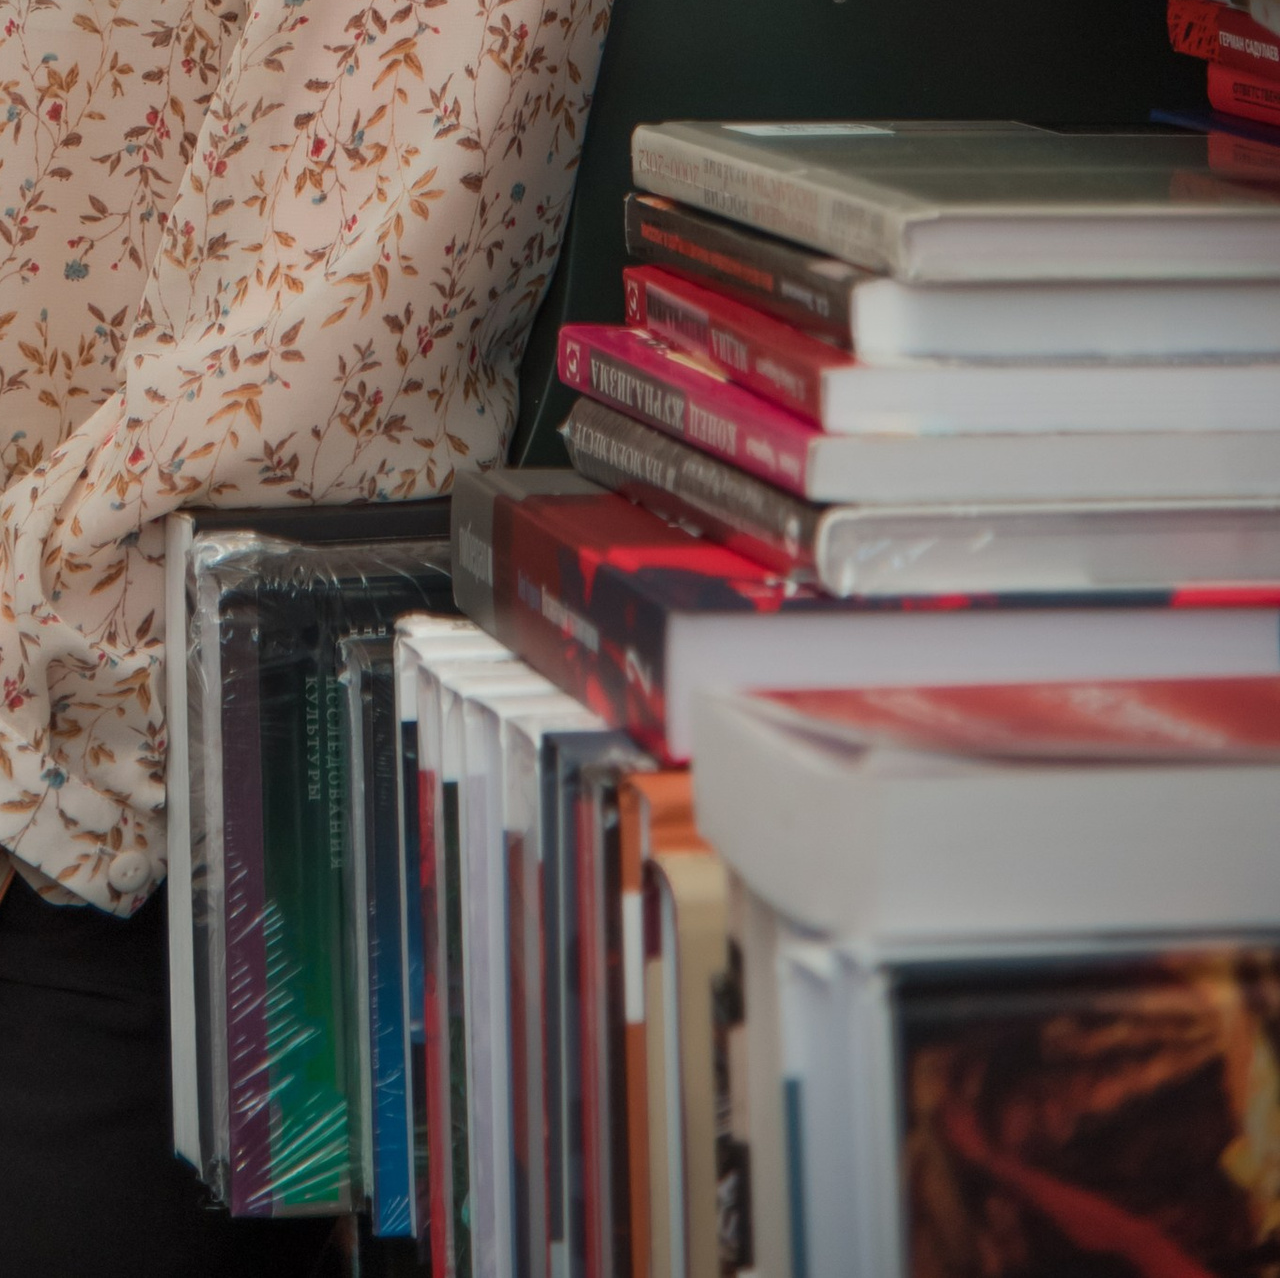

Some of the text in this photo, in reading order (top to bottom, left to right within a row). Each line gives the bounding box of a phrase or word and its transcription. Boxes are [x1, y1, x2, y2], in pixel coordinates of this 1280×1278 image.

[1219, 30, 1279, 62] ГЕРМАН САДУЛАЕВ
[590, 357, 685, 431] ЖУРНАЛИЗМА
[305, 674, 322, 802] КУЛЬТУРЫ
[325, 674, 343, 870] ИССЛЕДОВАНИЯ
